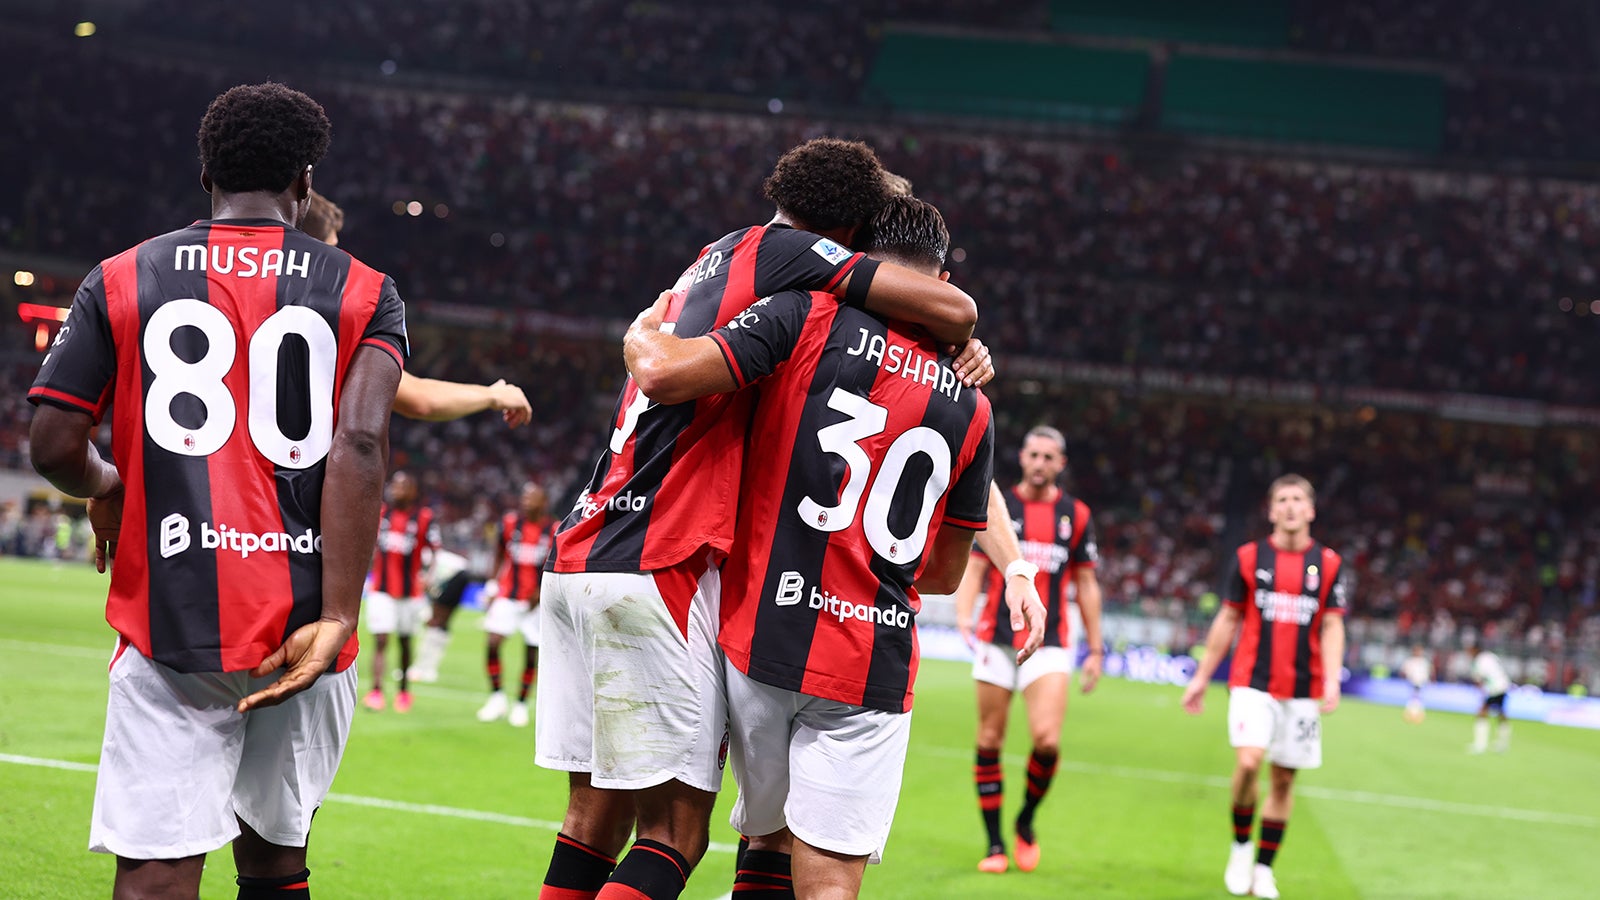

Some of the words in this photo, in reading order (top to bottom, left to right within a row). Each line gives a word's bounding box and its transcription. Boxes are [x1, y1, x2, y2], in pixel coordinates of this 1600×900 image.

[175, 244, 311, 279] MUSAH
[143, 298, 338, 469] 80
[847, 327, 963, 403] JASHARI
[797, 386, 952, 565] 30
[808, 586, 910, 629] bitpanda
